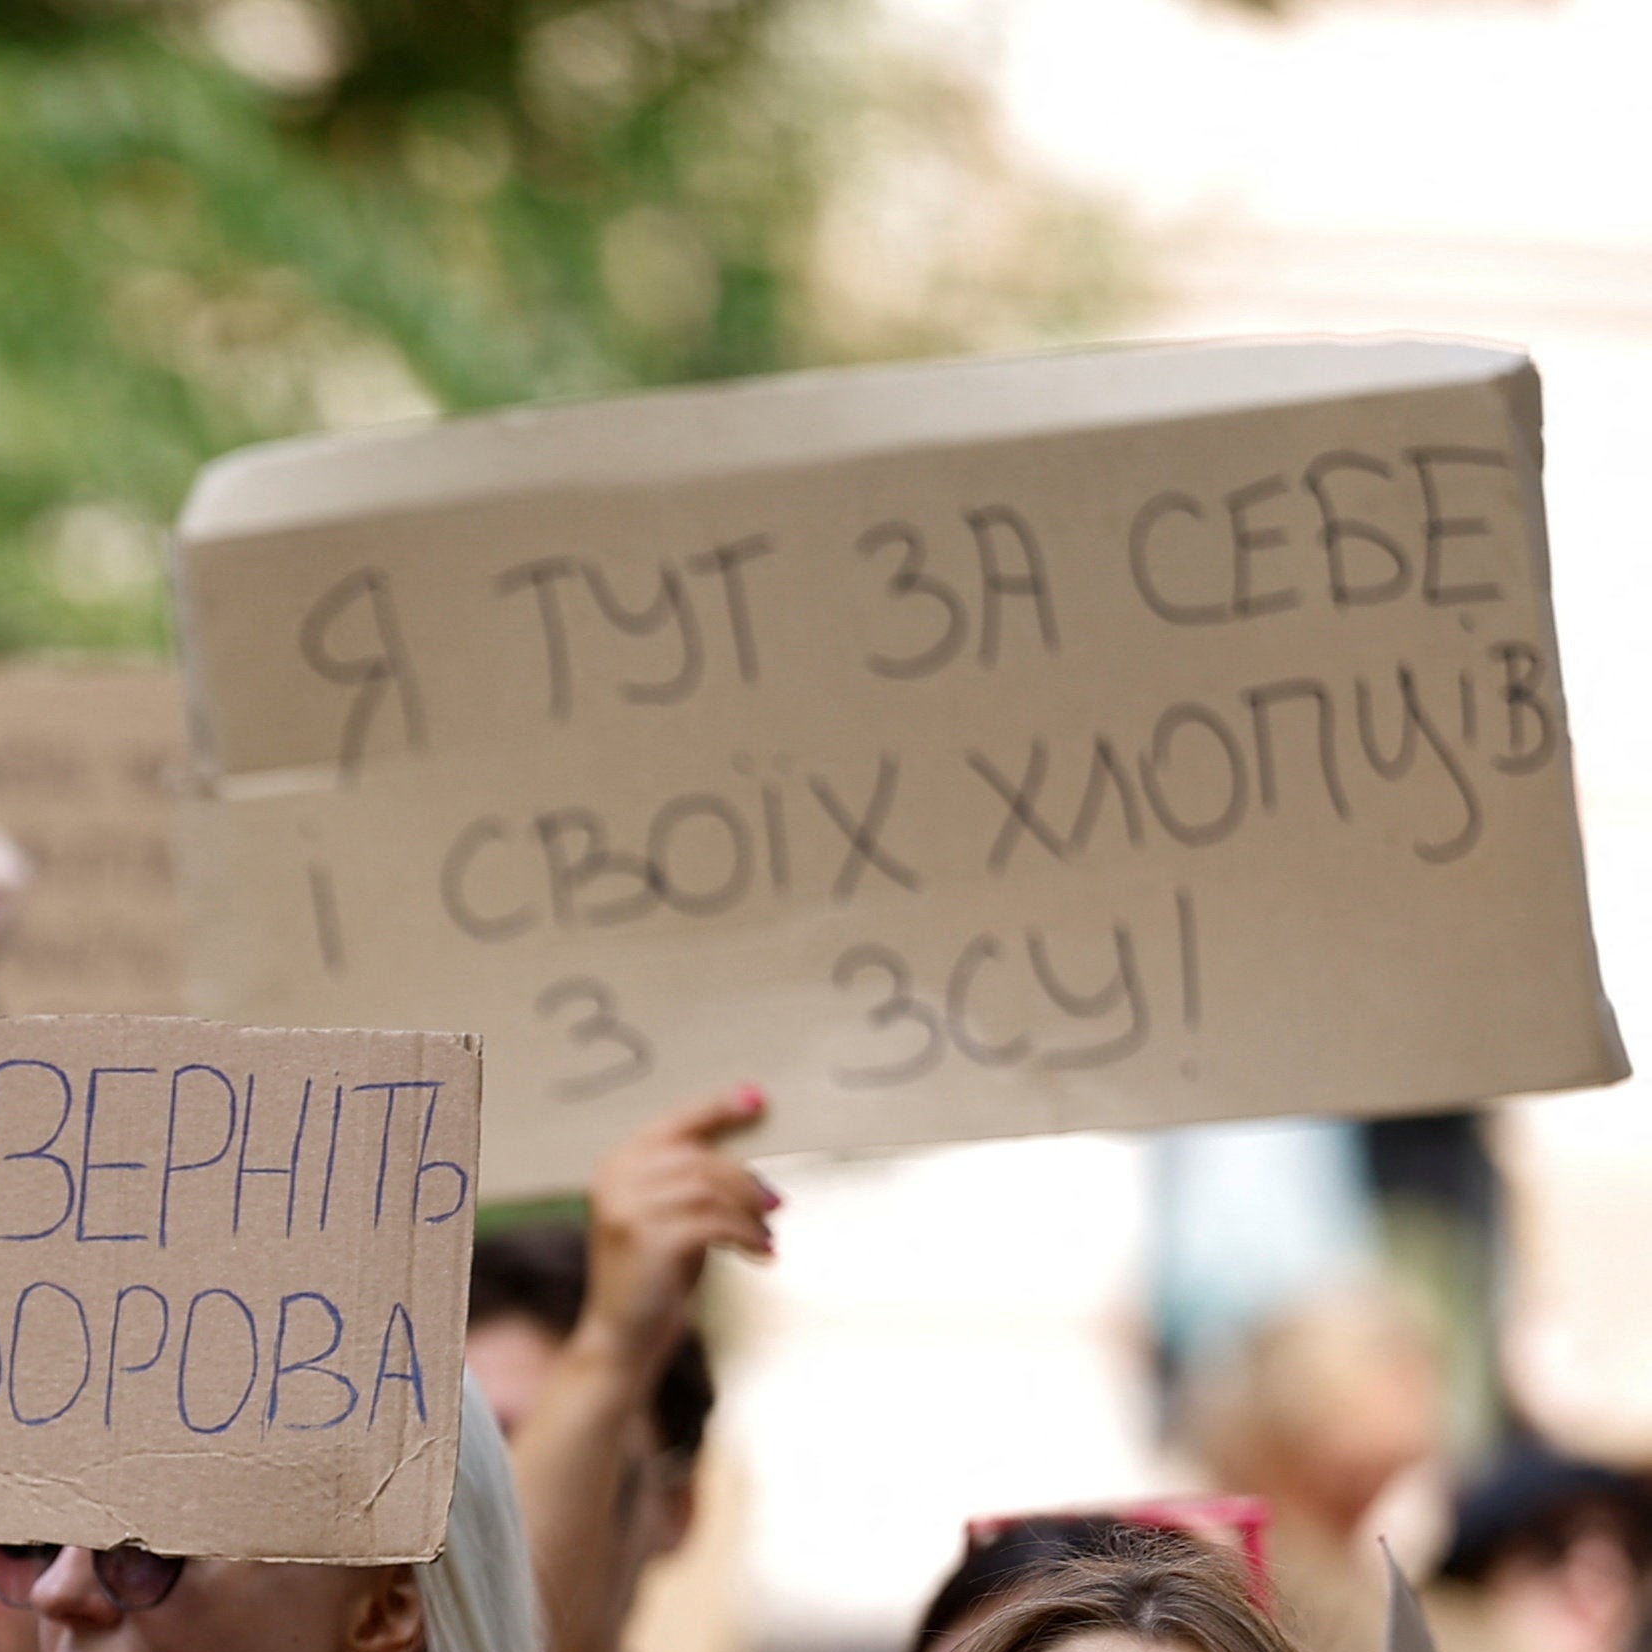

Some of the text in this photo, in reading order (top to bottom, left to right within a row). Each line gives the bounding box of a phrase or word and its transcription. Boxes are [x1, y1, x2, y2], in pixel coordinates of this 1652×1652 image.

[298, 442, 1511, 790] Я ТУТ ЗА СЕБЕ
[437, 750, 924, 942] СВОЇХ
[827, 889, 1207, 1090] ЗСУ!
